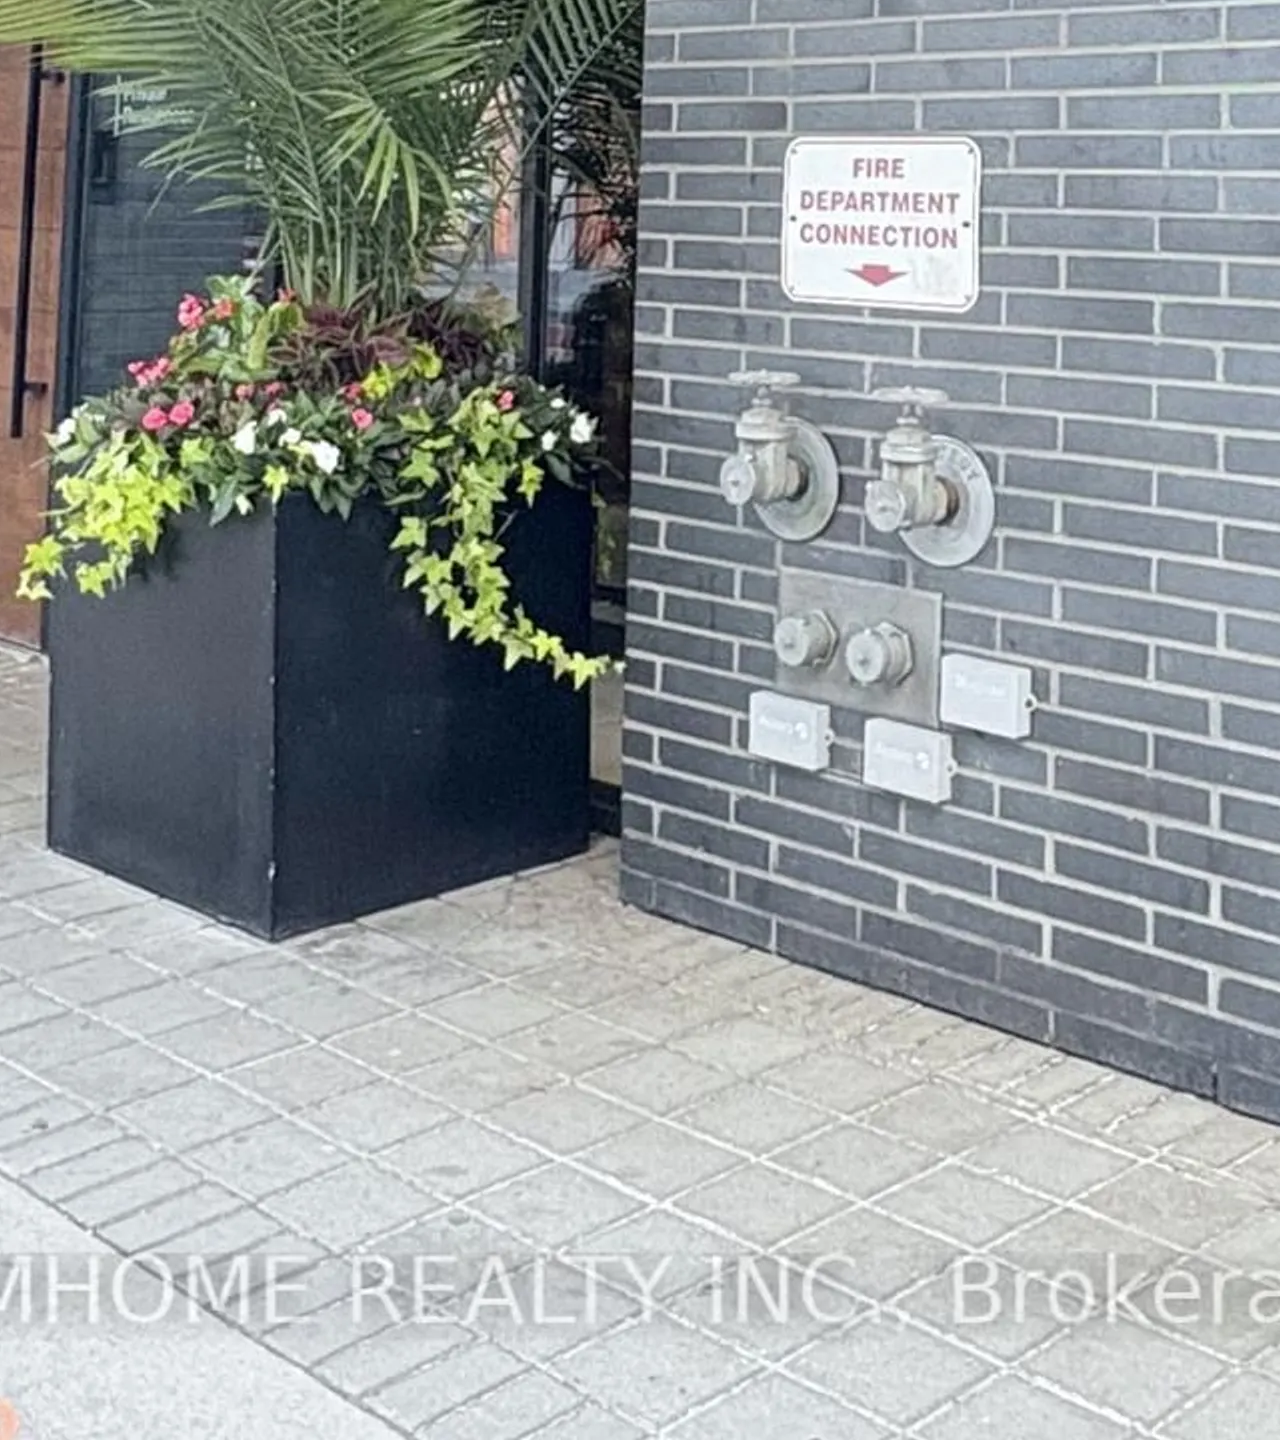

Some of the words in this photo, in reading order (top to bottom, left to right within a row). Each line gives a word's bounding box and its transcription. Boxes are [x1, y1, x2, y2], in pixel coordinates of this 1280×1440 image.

[852, 158, 906, 179] FIRE
[800, 190, 961, 214] DEPARTMENT
[800, 222, 959, 249] CONNECTION
